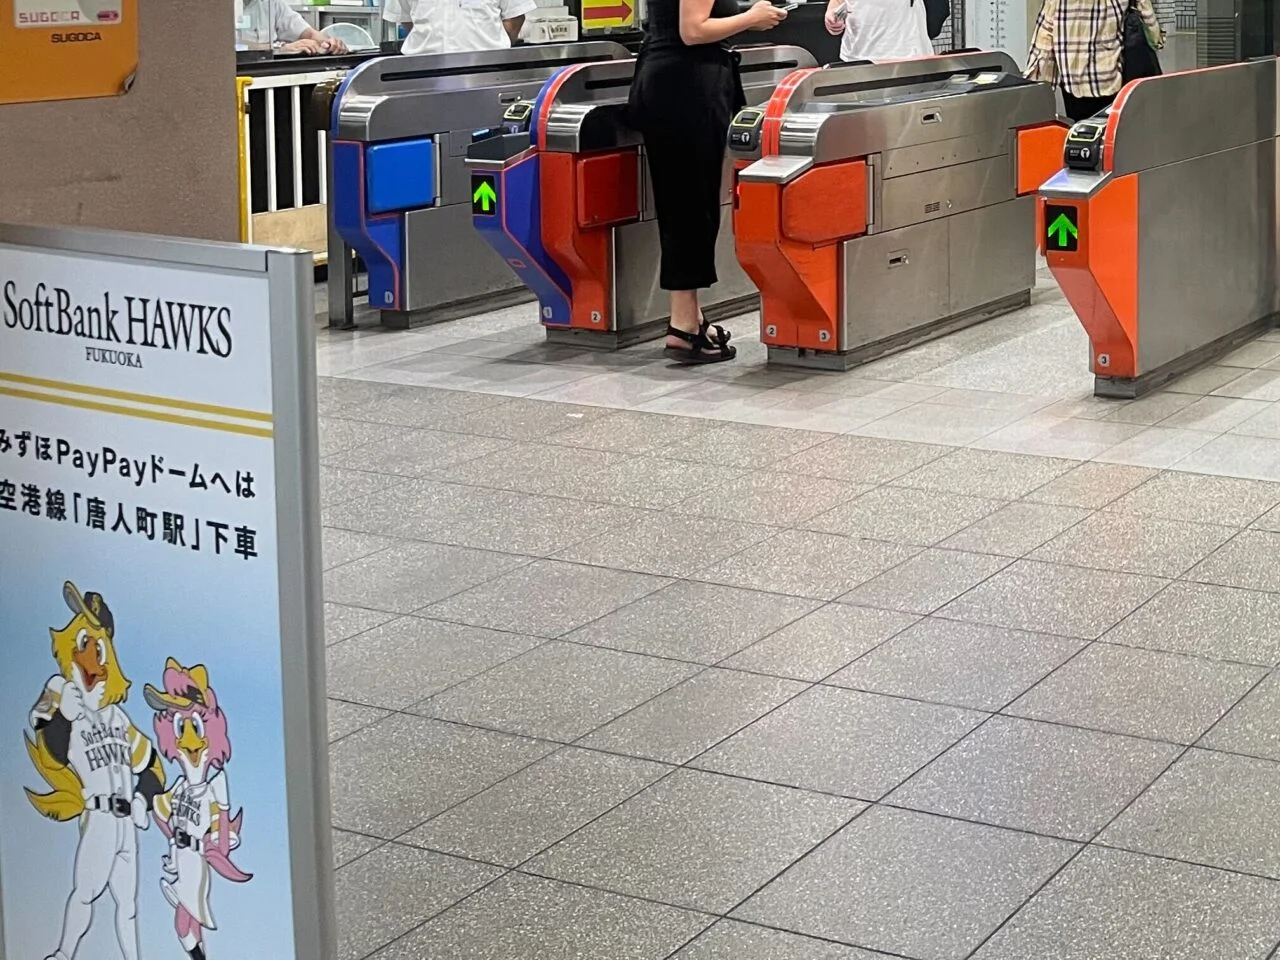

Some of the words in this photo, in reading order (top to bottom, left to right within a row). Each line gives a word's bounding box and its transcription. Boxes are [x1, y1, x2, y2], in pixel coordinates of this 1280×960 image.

[51, 32, 102, 44] SUGOCA
[3, 280, 122, 343] SoftBank
[124, 296, 232, 358] HAWKS
[593, 313, 598, 321] 2
[769, 327, 774, 335] 2
[822, 331, 827, 340] 3
[85, 346, 143, 368] FUKUOKA
[1102, 356, 1107, 364] 3
[0, 479, 258, 560] 空港線「唐人町駅」下車
